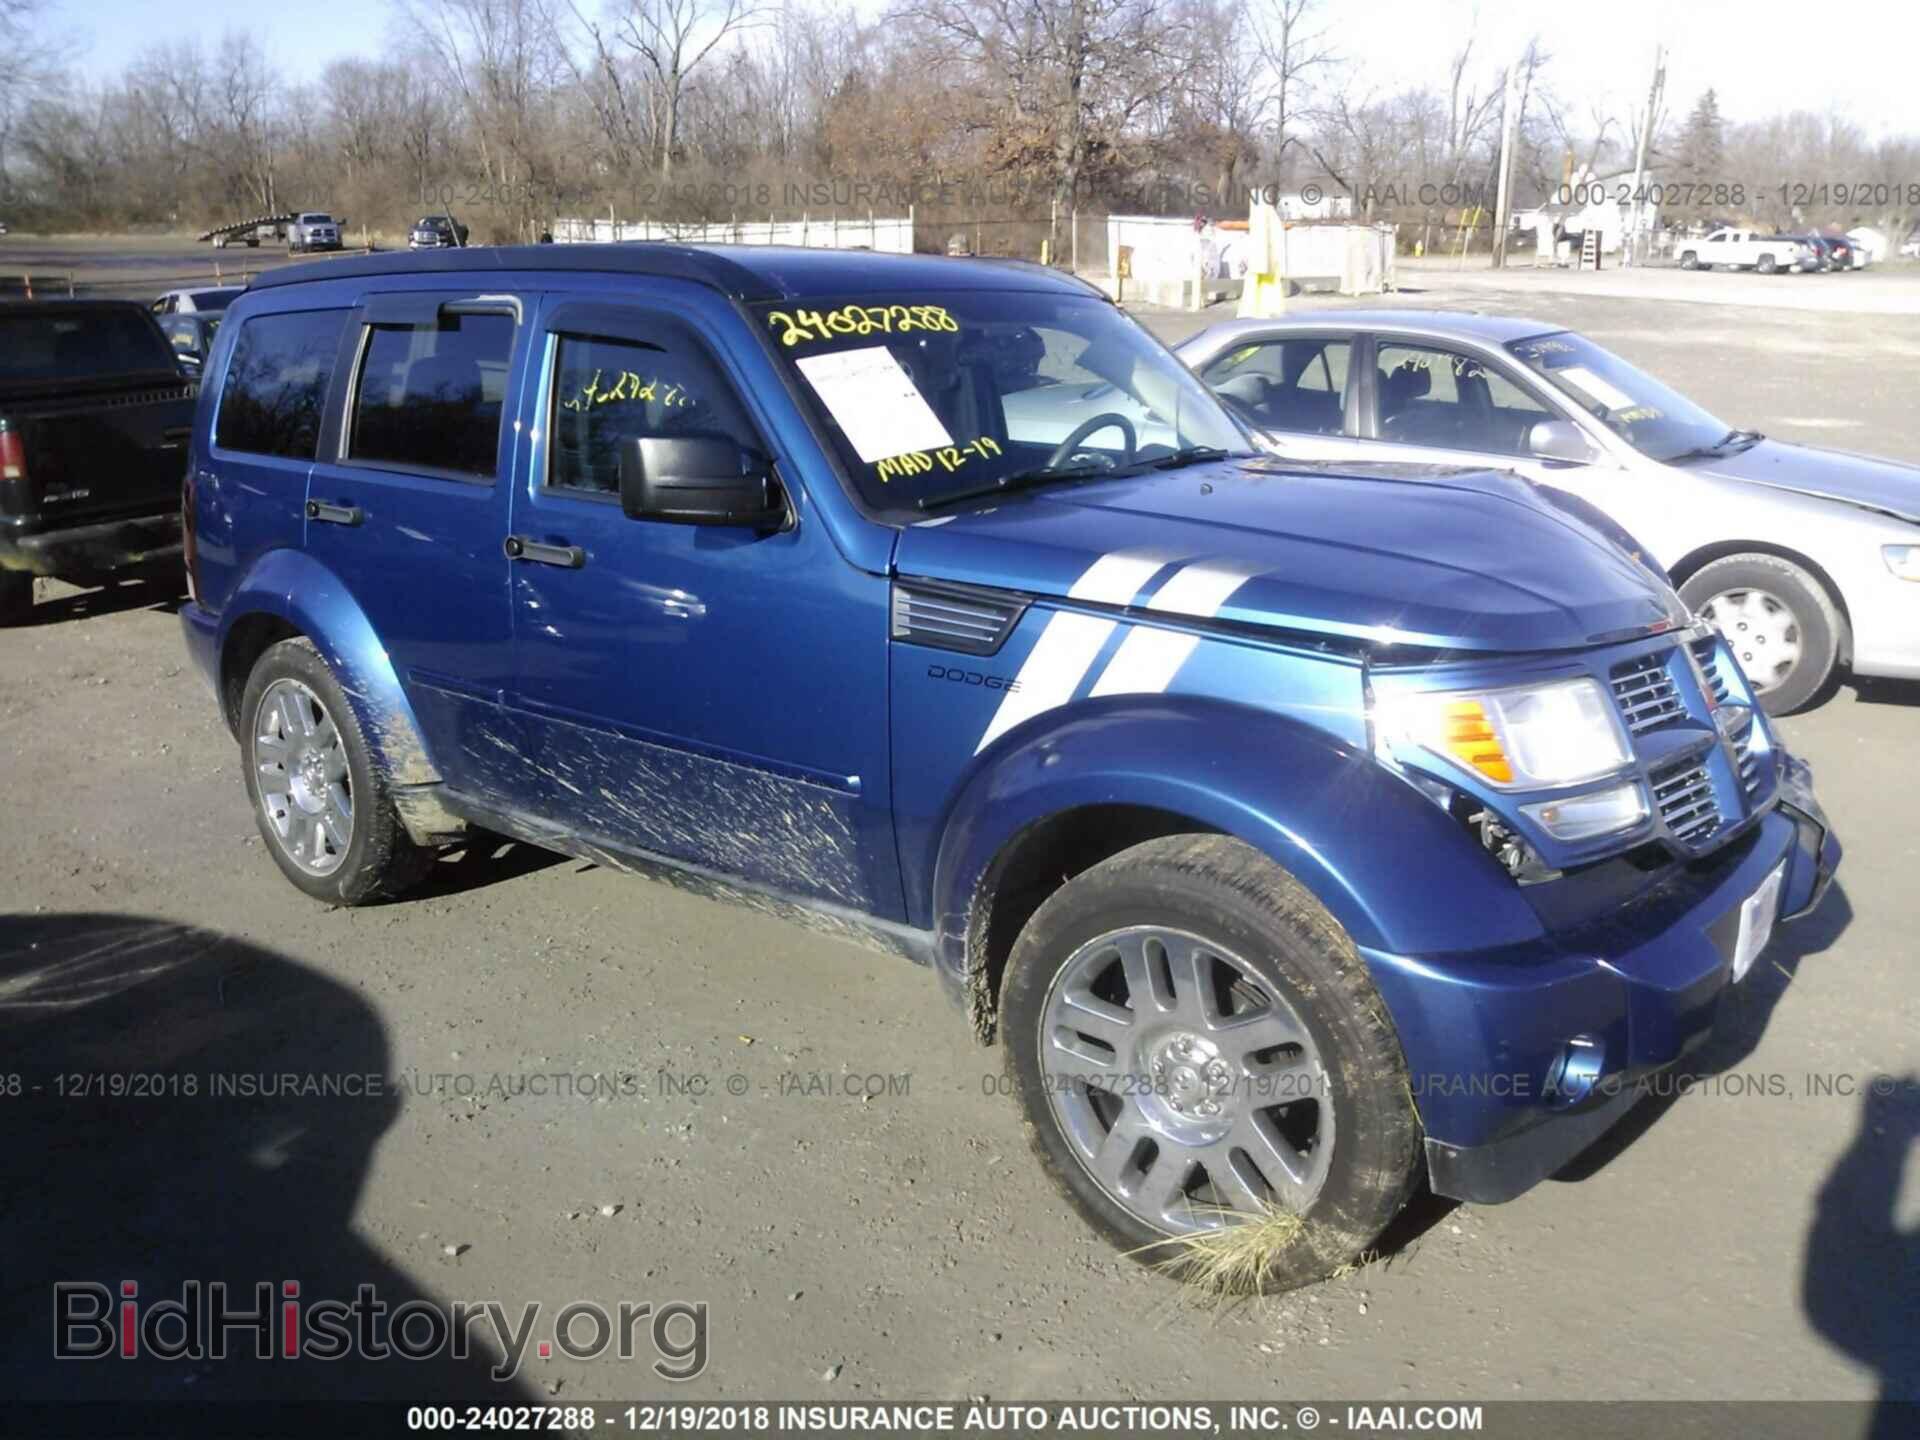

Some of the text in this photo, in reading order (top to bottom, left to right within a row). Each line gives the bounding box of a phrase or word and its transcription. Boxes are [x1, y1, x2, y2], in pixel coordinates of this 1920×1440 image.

[768, 305, 958, 346] 24027288
[877, 437, 1002, 482] MAD 12-19
[928, 665, 1022, 693] DODGE
